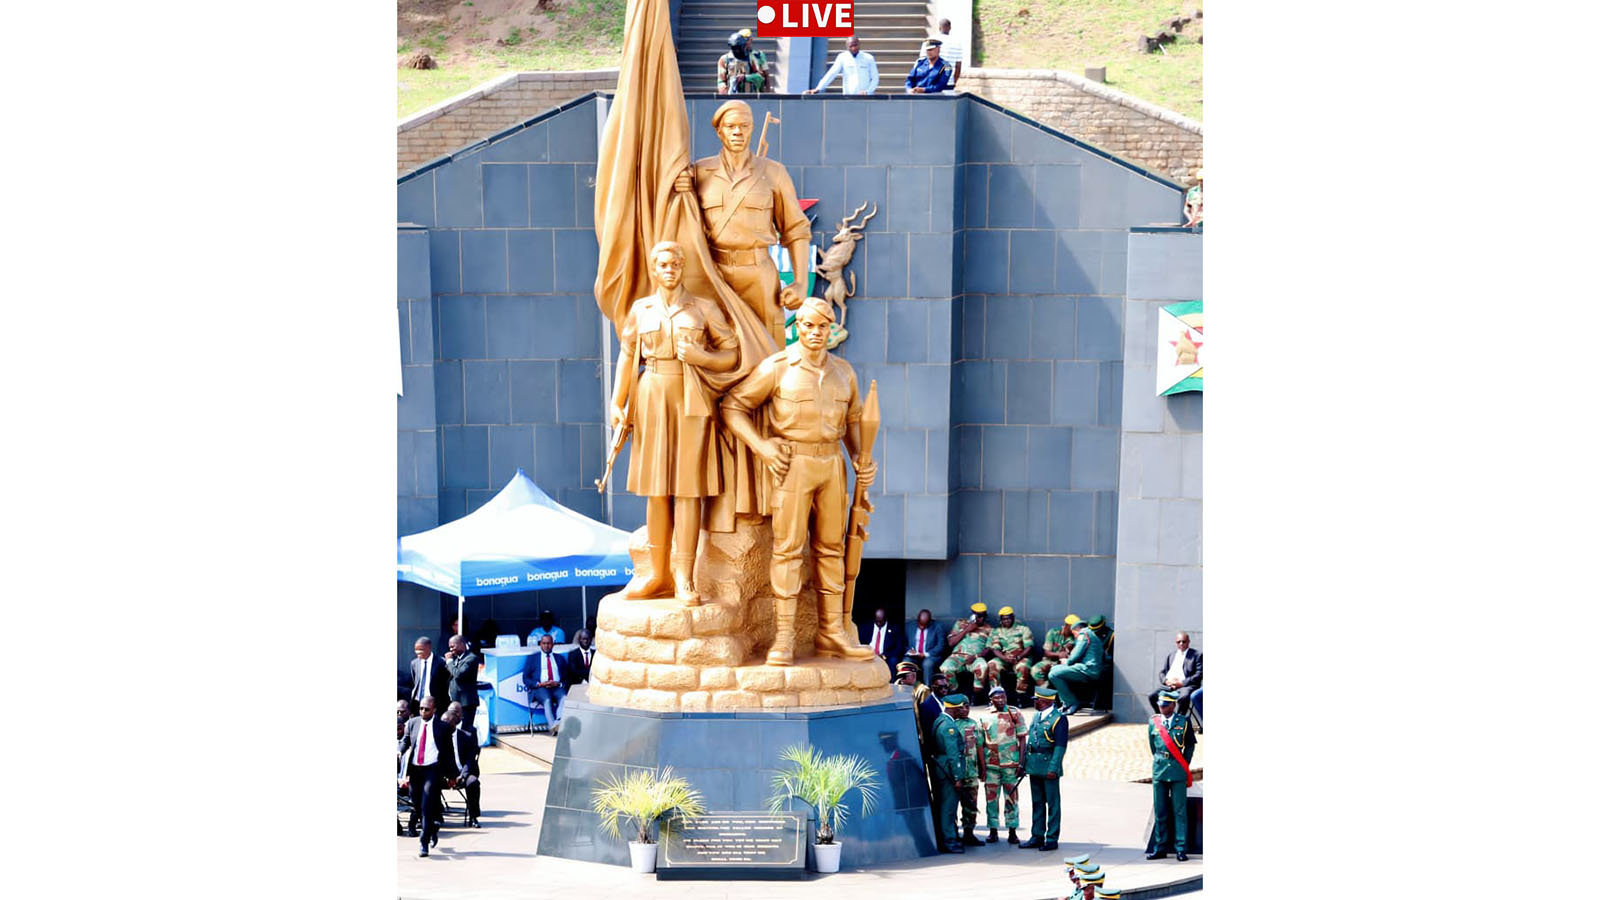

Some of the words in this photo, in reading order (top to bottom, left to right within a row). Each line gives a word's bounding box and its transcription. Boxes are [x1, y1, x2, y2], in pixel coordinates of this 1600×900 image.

[476, 576, 518, 587] bonaqua
[527, 569, 568, 582] bonaqua
[575, 568, 616, 580] bonaqua
